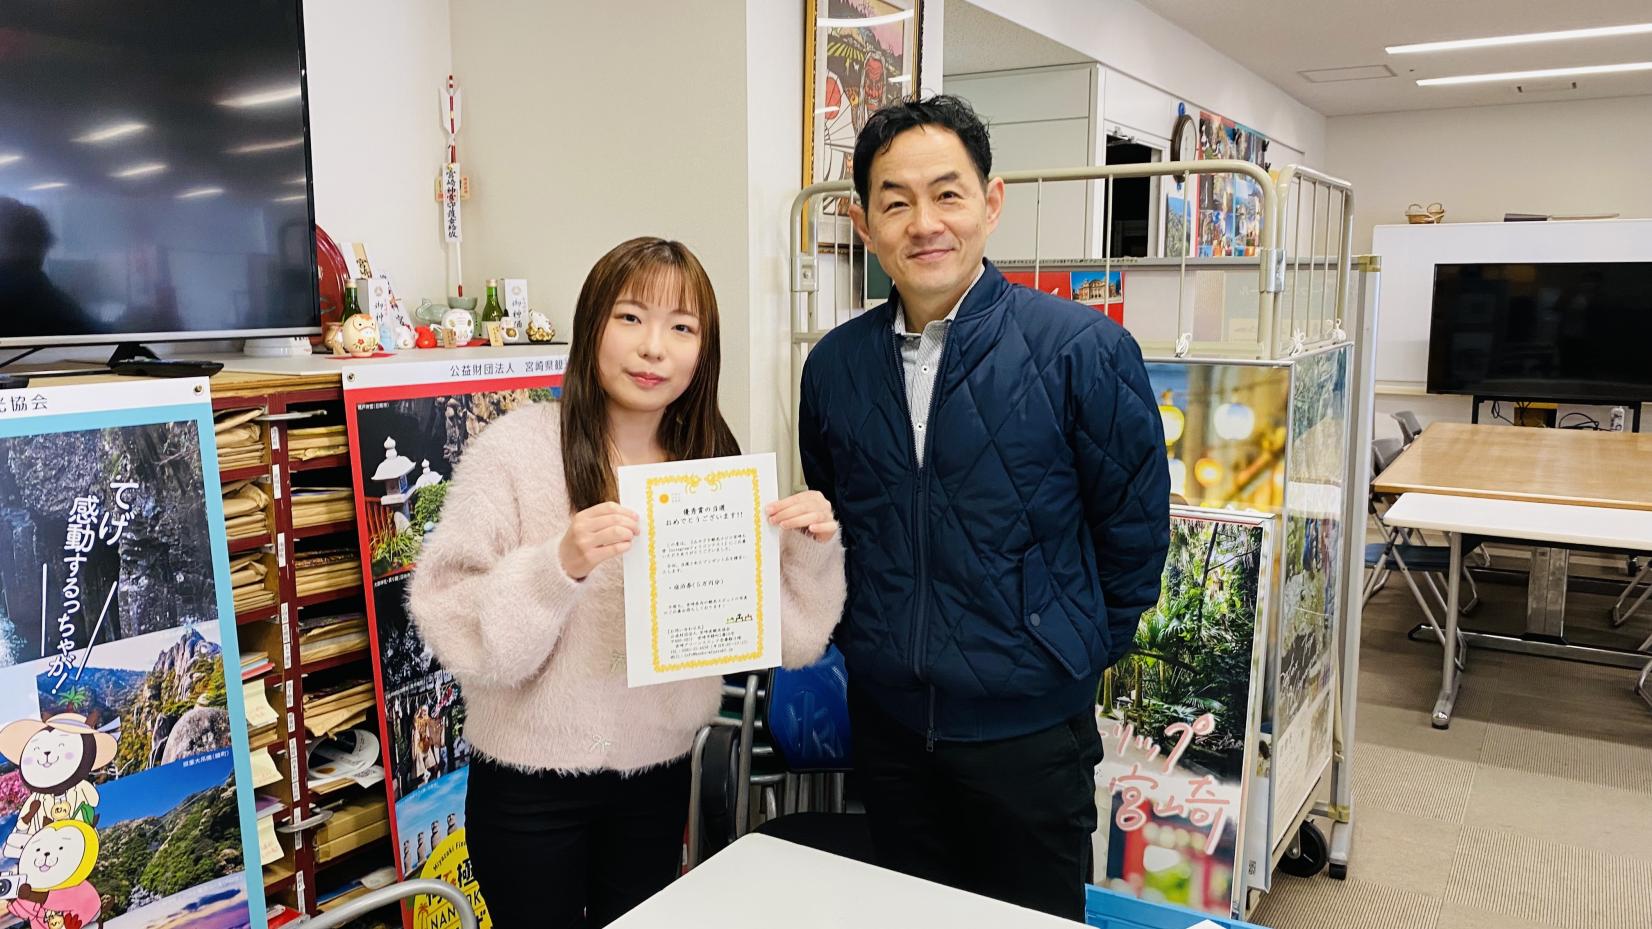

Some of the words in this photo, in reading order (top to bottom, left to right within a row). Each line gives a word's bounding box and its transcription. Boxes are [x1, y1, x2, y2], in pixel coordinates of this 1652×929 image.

[450, 363, 515, 377] 公益財団法人
[98, 475, 140, 546] てげ
[683, 504, 725, 516] 優秀賞の当選
